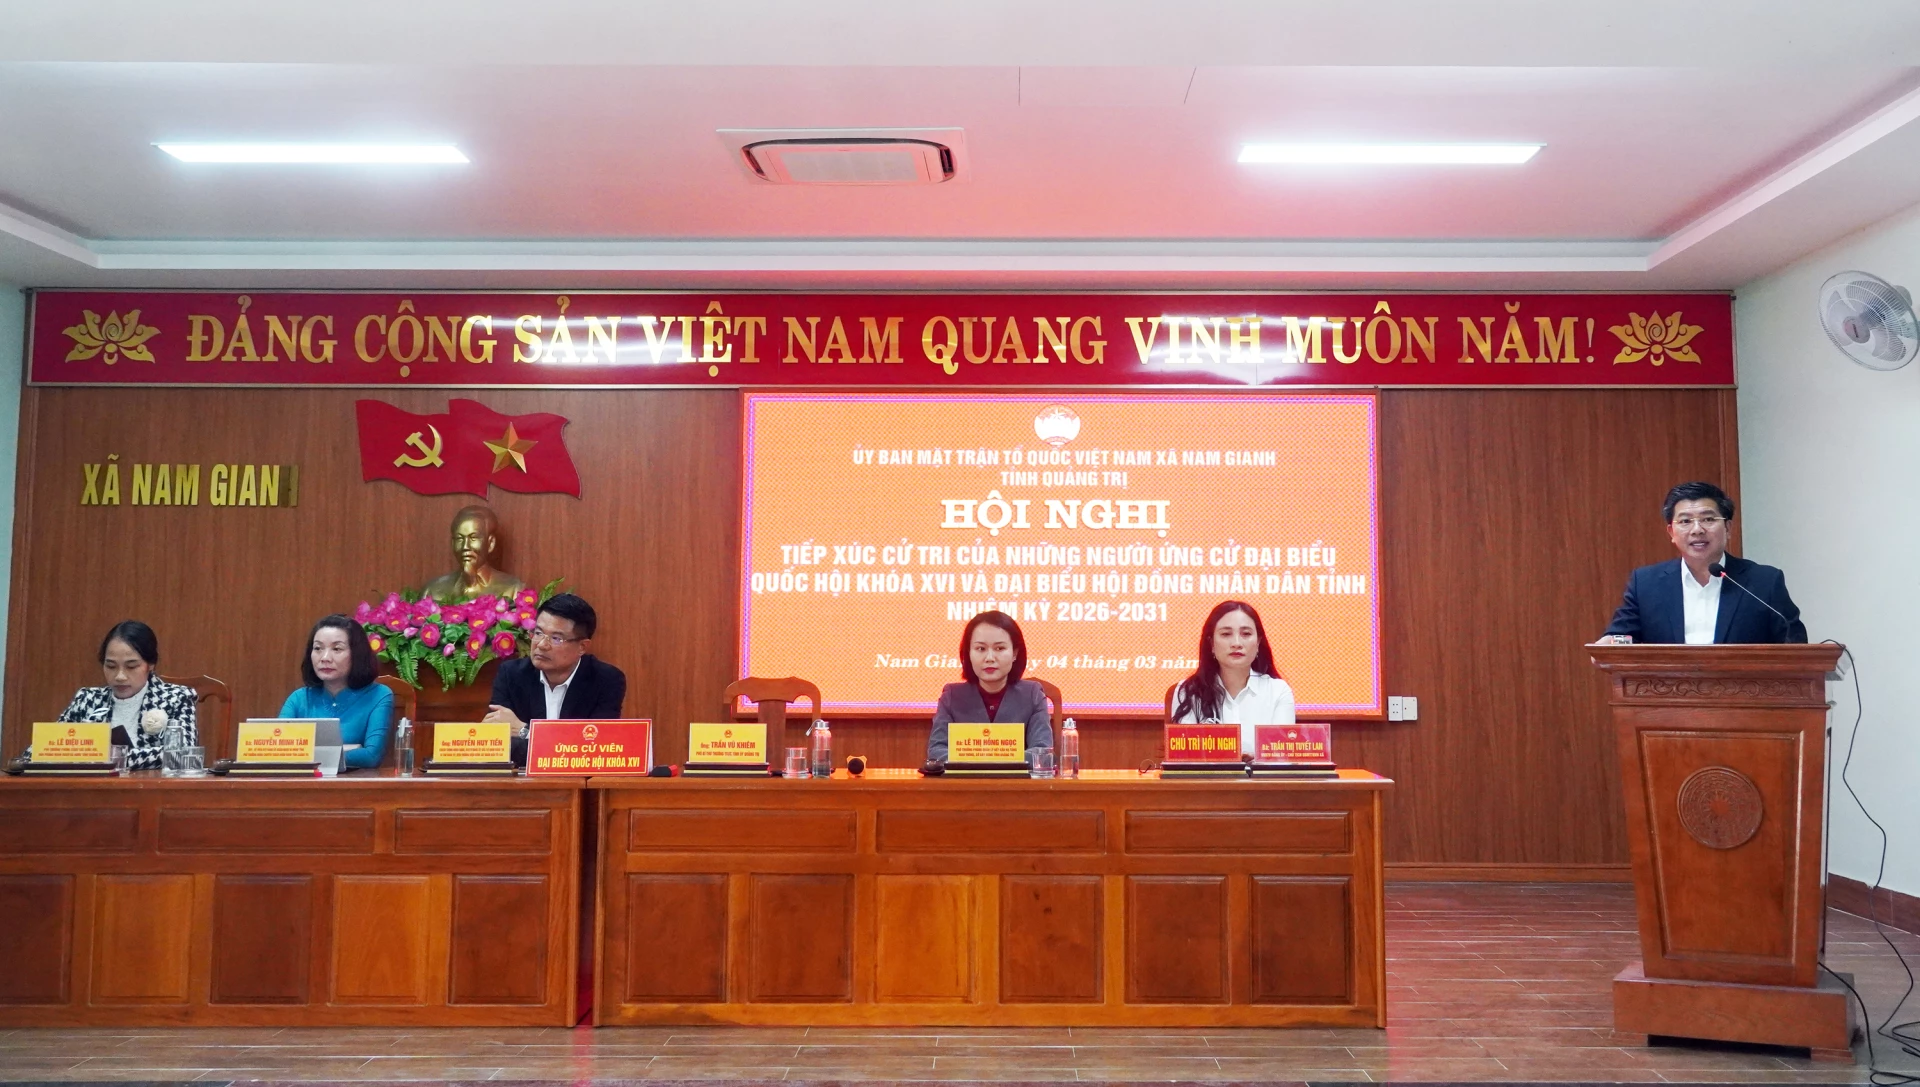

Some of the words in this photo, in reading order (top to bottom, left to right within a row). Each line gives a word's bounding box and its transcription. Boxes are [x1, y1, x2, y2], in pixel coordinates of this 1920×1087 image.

[187, 295, 338, 364] ĐẢNG
[354, 300, 497, 378] CỘNG
[514, 295, 618, 364] SẢN
[642, 301, 767, 377] VIỆT
[782, 316, 905, 364] NAM
[921, 315, 1108, 375] QUANG
[1125, 314, 1260, 364] VINH
[1282, 301, 1437, 364] MUÔN
[1457, 301, 1595, 364] NĂM!
[853, 444, 874, 464] ỦY
[879, 449, 912, 465] BAN
[916, 447, 952, 467] MẶT
[956, 447, 998, 467] TRẬN
[1027, 443, 1071, 467] QUỐC
[1075, 447, 1109, 468] VIỆT
[1113, 450, 1151, 465] NAM
[1156, 447, 1177, 465] XÃ
[1182, 450, 1220, 466] NAM
[1225, 450, 1276, 466] GIANH
[80, 454, 121, 506] XÃ
[131, 463, 200, 506] NAM
[1001, 467, 1038, 486] TỈNH
[1042, 466, 1098, 487] QUẢNG
[1102, 471, 1128, 489] TRỊ
[940, 490, 1031, 537] HỘI
[1044, 498, 1170, 538] NGHỊ
[781, 538, 827, 565] TIẾP
[833, 541, 875, 565] XÚC
[882, 538, 913, 565] CỬ
[917, 546, 950, 565] TRI
[956, 539, 1000, 565] CỦA
[1005, 541, 1081, 566] NHỮNG
[1086, 541, 1153, 566] NGƯỜI
[1159, 541, 1203, 566] ỨNG
[1210, 539, 1241, 566] CỬ
[1244, 547, 1280, 570] ĐẠI
[1287, 539, 1336, 566] BIỂU
[751, 566, 808, 593] QUỐC
[815, 569, 850, 597] HỘI
[857, 569, 914, 593] KHÓA
[920, 574, 955, 592] XVI
[961, 570, 988, 592] VÀ
[994, 574, 1030, 597] ĐẠI
[1037, 566, 1086, 593] BIỂU
[1092, 570, 1128, 597] HỘI
[1134, 567, 1193, 593] ĐỒNG
[1200, 570, 1260, 593] NHÂN
[1266, 570, 1311, 593] DÂN
[1317, 567, 1366, 594] TỈNH
[1024, 598, 1050, 621] KỲ
[1057, 602, 1168, 621] 2026-2031
[874, 654, 919, 668] Nam
[925, 654, 962, 668] Gia
[1047, 655, 1068, 669] 04
[1074, 654, 1130, 671] tháng
[1134, 655, 1157, 669] 03
[555, 742, 578, 753] ỨNG
[581, 741, 597, 753] CỬ
[599, 743, 624, 753] VIÊN
[973, 739, 982, 747] THỊ
[1001, 739, 1017, 747] NGỌC
[1170, 733, 1186, 750] CHỦ
[1188, 735, 1200, 750] TRÌ
[1202, 735, 1215, 753] HỘI
[1217, 737, 1236, 753] NGHỊ
[1286, 742, 1294, 752] THỊ
[1312, 742, 1323, 750] LAN
[537, 757, 550, 770] ĐẠI
[552, 754, 569, 768] BIỂU
[570, 754, 590, 769] QUỐC
[592, 755, 604, 770] HỘI
[606, 755, 626, 767] KHÓA
[628, 757, 640, 767] XVI
